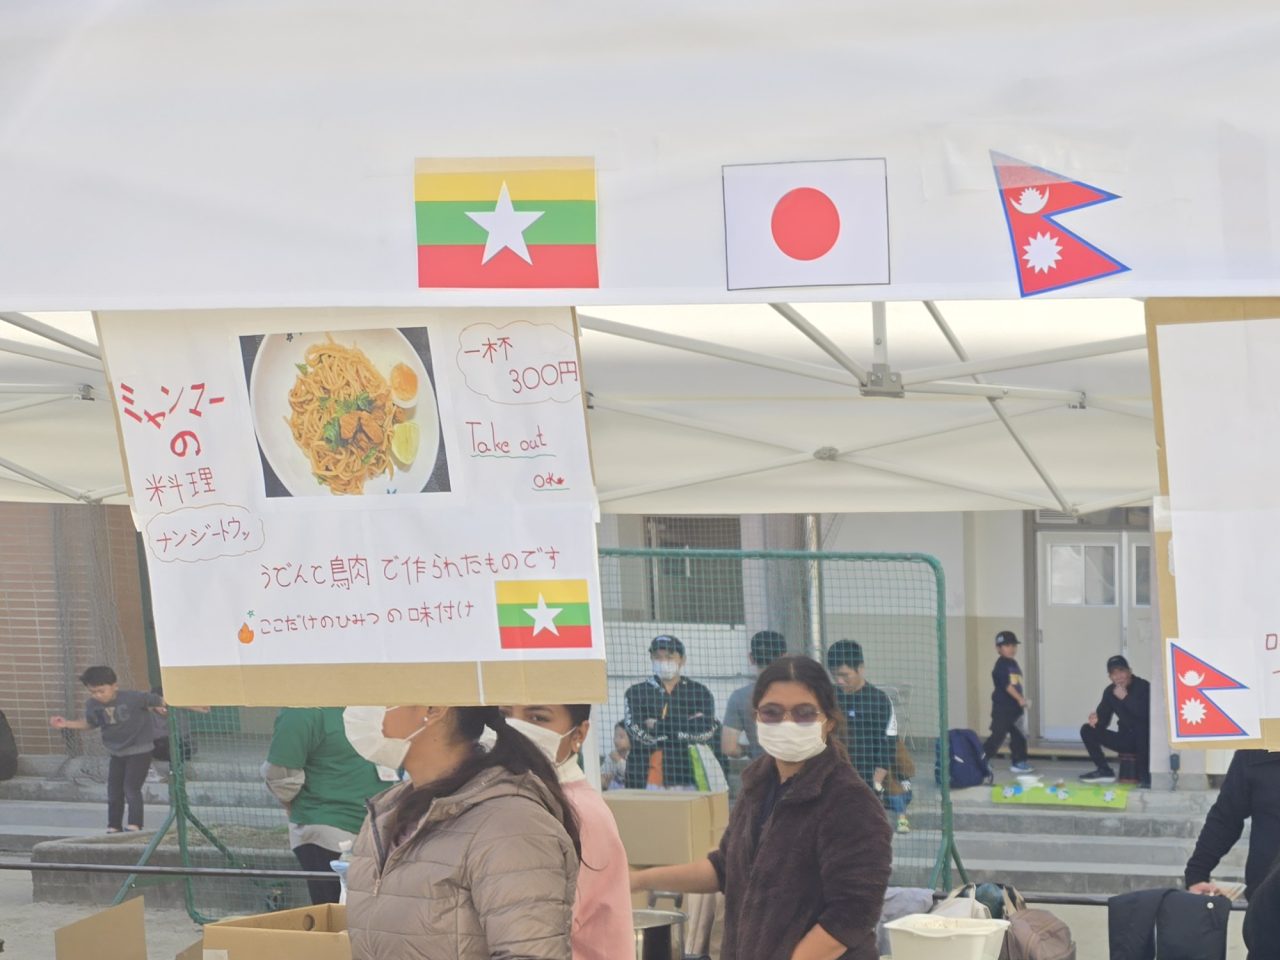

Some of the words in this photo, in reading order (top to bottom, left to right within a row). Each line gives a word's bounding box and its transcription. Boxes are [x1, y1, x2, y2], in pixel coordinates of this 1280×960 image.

[463, 337, 514, 364] 一杯
[508, 360, 578, 394] 300円
[120, 381, 225, 429] ミャンマー
[169, 430, 202, 458] の
[465, 421, 511, 454] Take
[519, 424, 548, 451] out
[144, 467, 217, 505] 料理
